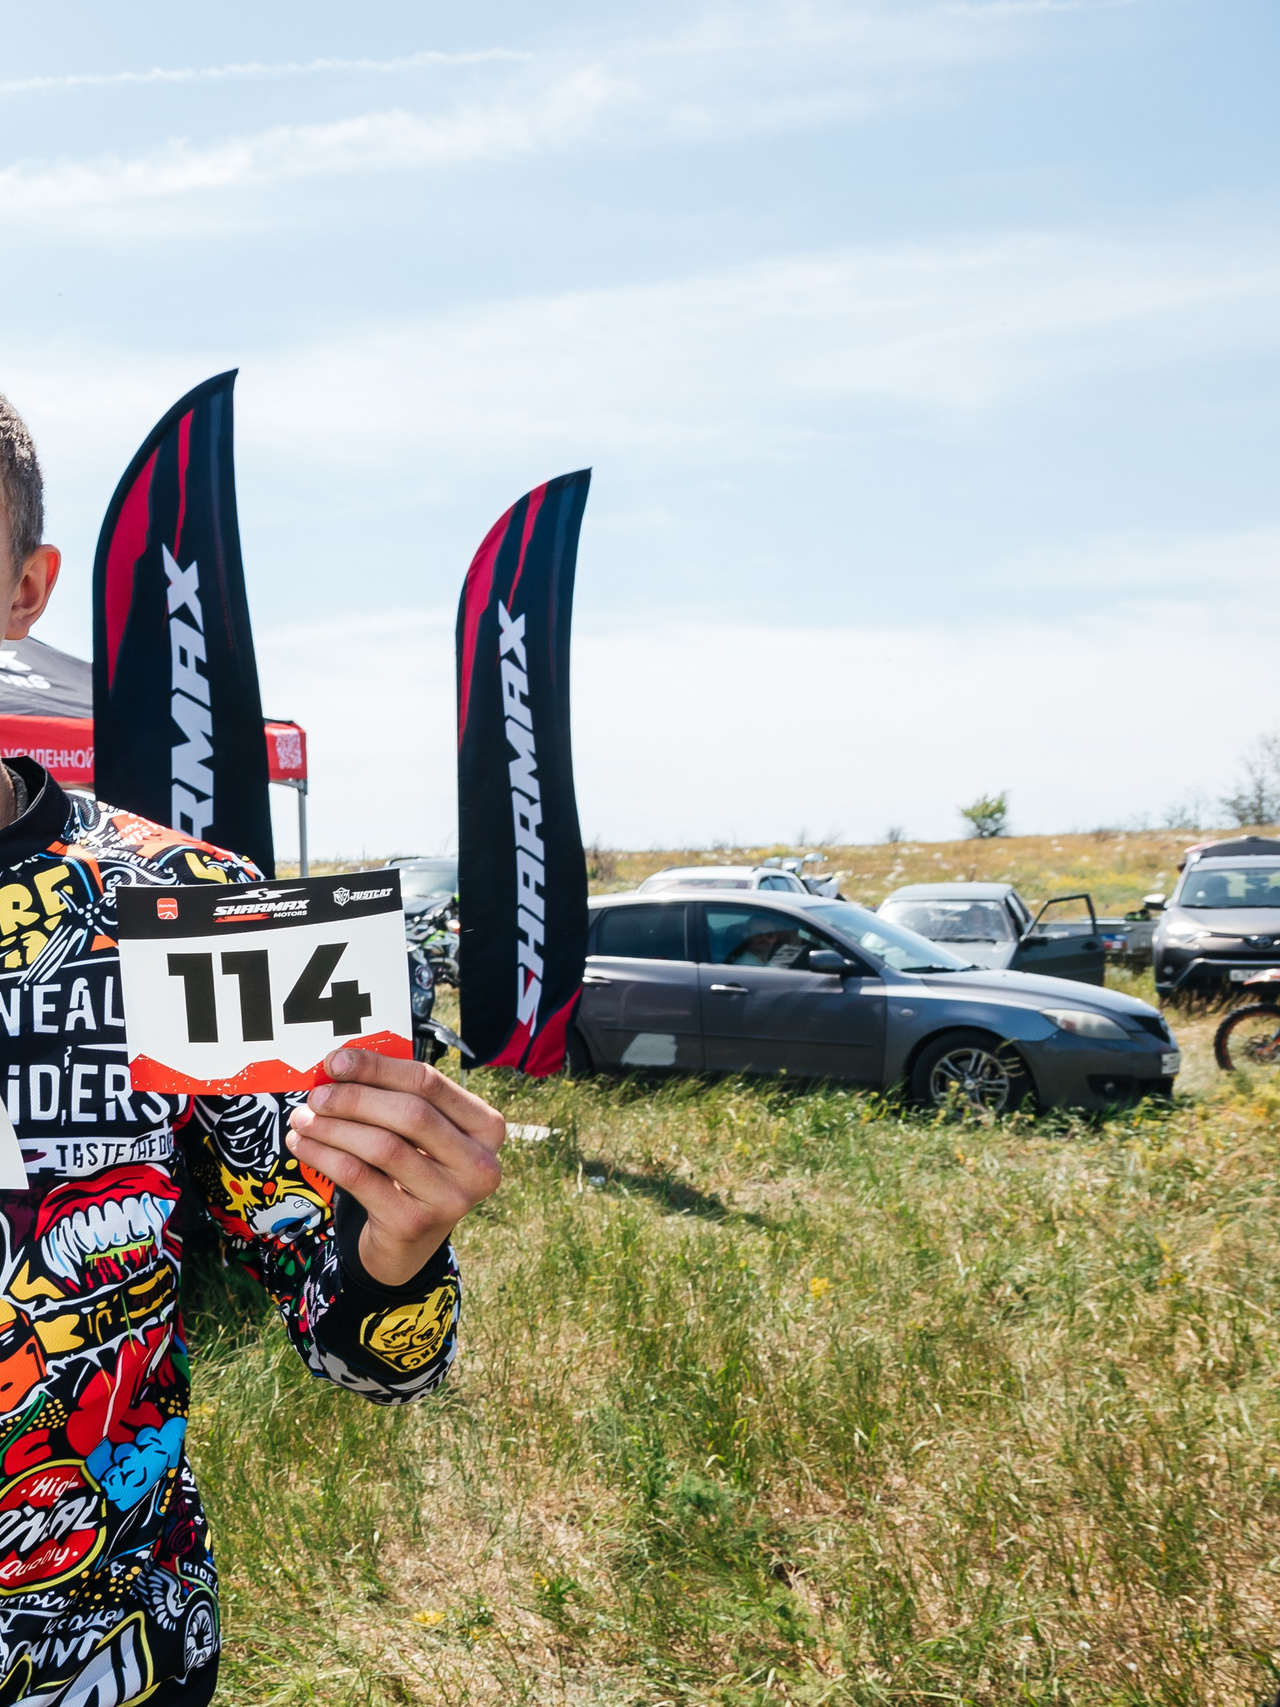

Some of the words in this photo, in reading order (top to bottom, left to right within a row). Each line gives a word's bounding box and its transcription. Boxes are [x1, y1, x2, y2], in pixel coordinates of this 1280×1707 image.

[498, 600, 546, 1036] SHARMAX
[349, 888, 393, 901] JUSTCAT
[213, 899, 310, 917] SHARMAX
[273, 910, 308, 918] MOTORS
[167, 942, 372, 1043] 114
